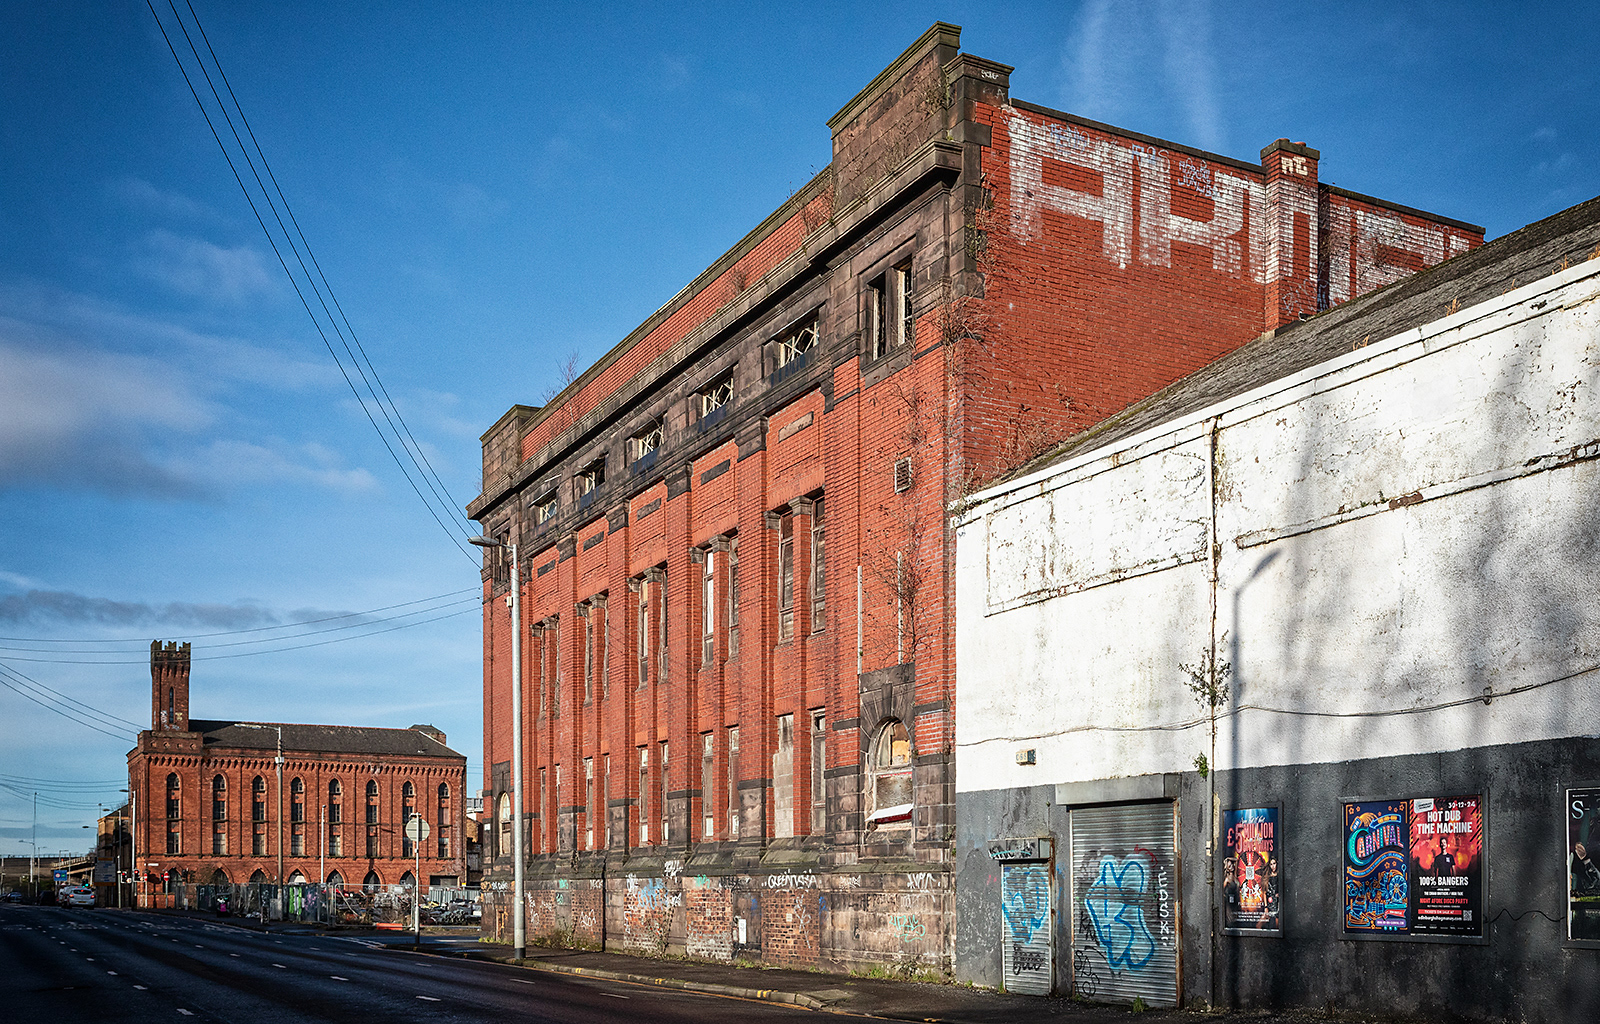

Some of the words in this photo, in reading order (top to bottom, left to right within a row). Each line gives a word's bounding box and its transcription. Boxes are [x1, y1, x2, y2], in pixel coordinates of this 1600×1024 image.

[1428, 811, 1443, 822] HOT
[1445, 810, 1461, 822] DUB
[1243, 822, 1274, 839] MILLION
[1417, 823, 1436, 835] TIME
[1437, 822, 1473, 834] MACHINE
[1419, 877, 1437, 886] 100%
[1438, 877, 1469, 886] BANGERS
